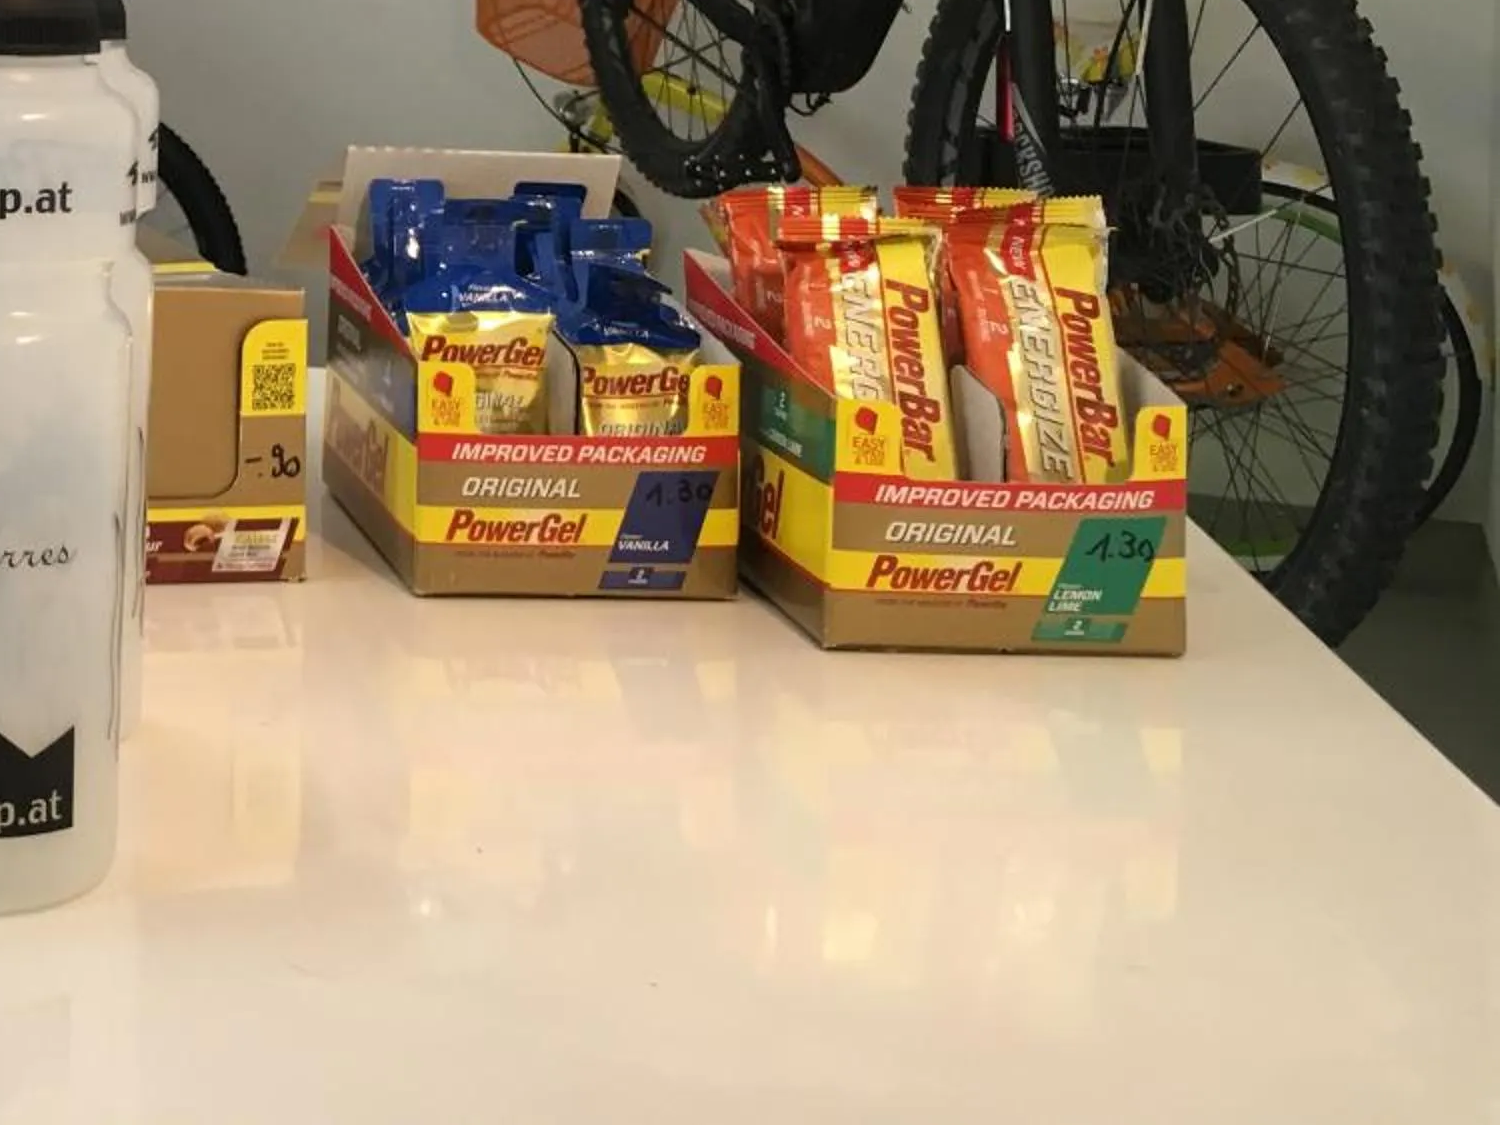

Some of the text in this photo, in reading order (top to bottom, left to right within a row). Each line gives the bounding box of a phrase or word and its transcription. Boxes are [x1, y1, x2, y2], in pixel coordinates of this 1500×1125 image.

[885, 279, 941, 465] PowerBar
[1054, 286, 1119, 468] PowerBar
[451, 441, 706, 464] IMPROVED PACKAGING
[461, 476, 582, 498] ORIGINAL
[874, 484, 1156, 511] IMPROVED PACKAGING
[445, 508, 588, 545] PowerGel
[884, 521, 1018, 547] ORIGINAL
[617, 539, 671, 552] VANILLA
[865, 554, 1023, 593] PowerGel
[1047, 601, 1083, 613] LIME
[1053, 589, 1104, 601] LEMON
